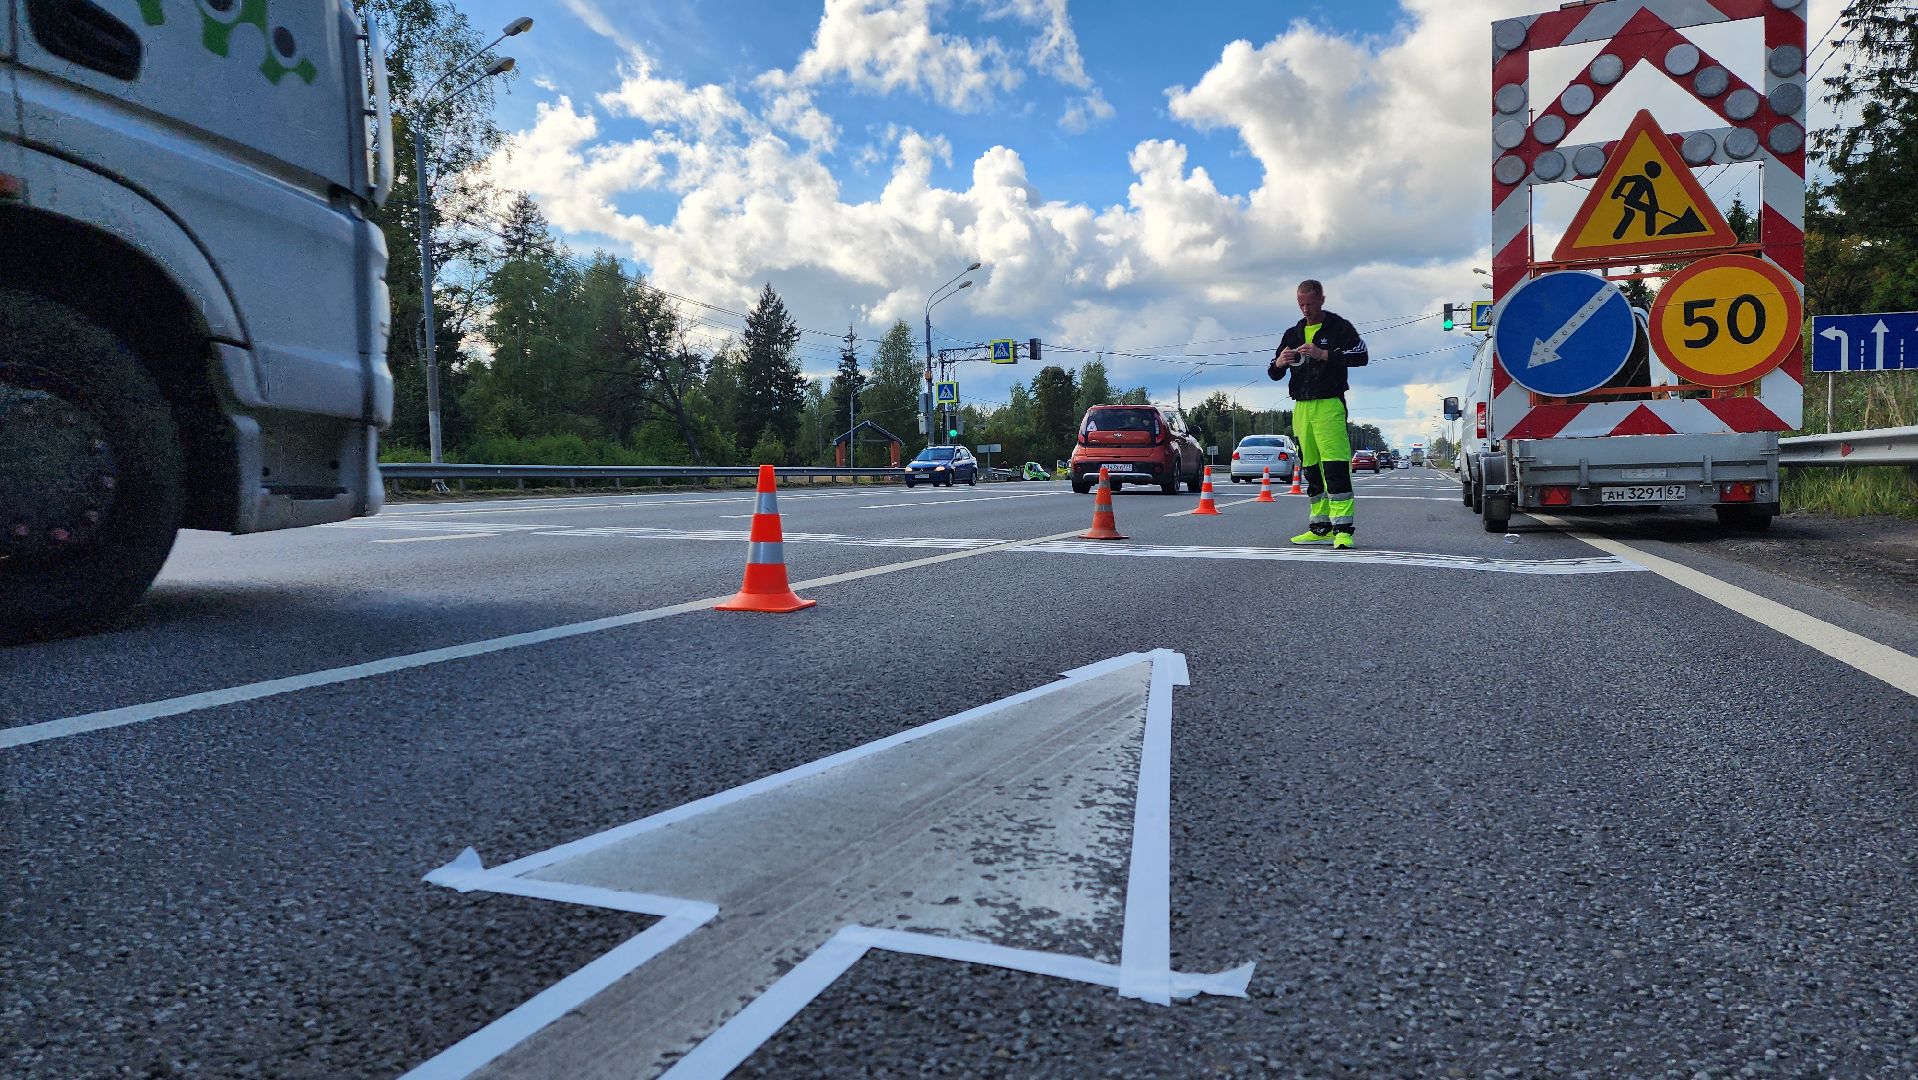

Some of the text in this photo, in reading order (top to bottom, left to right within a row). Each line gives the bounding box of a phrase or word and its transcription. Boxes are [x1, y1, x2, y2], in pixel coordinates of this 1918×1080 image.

[1684, 294, 1766, 349] 50
[1628, 488, 1663, 500] 3291
[1667, 486, 1681, 495] 67
